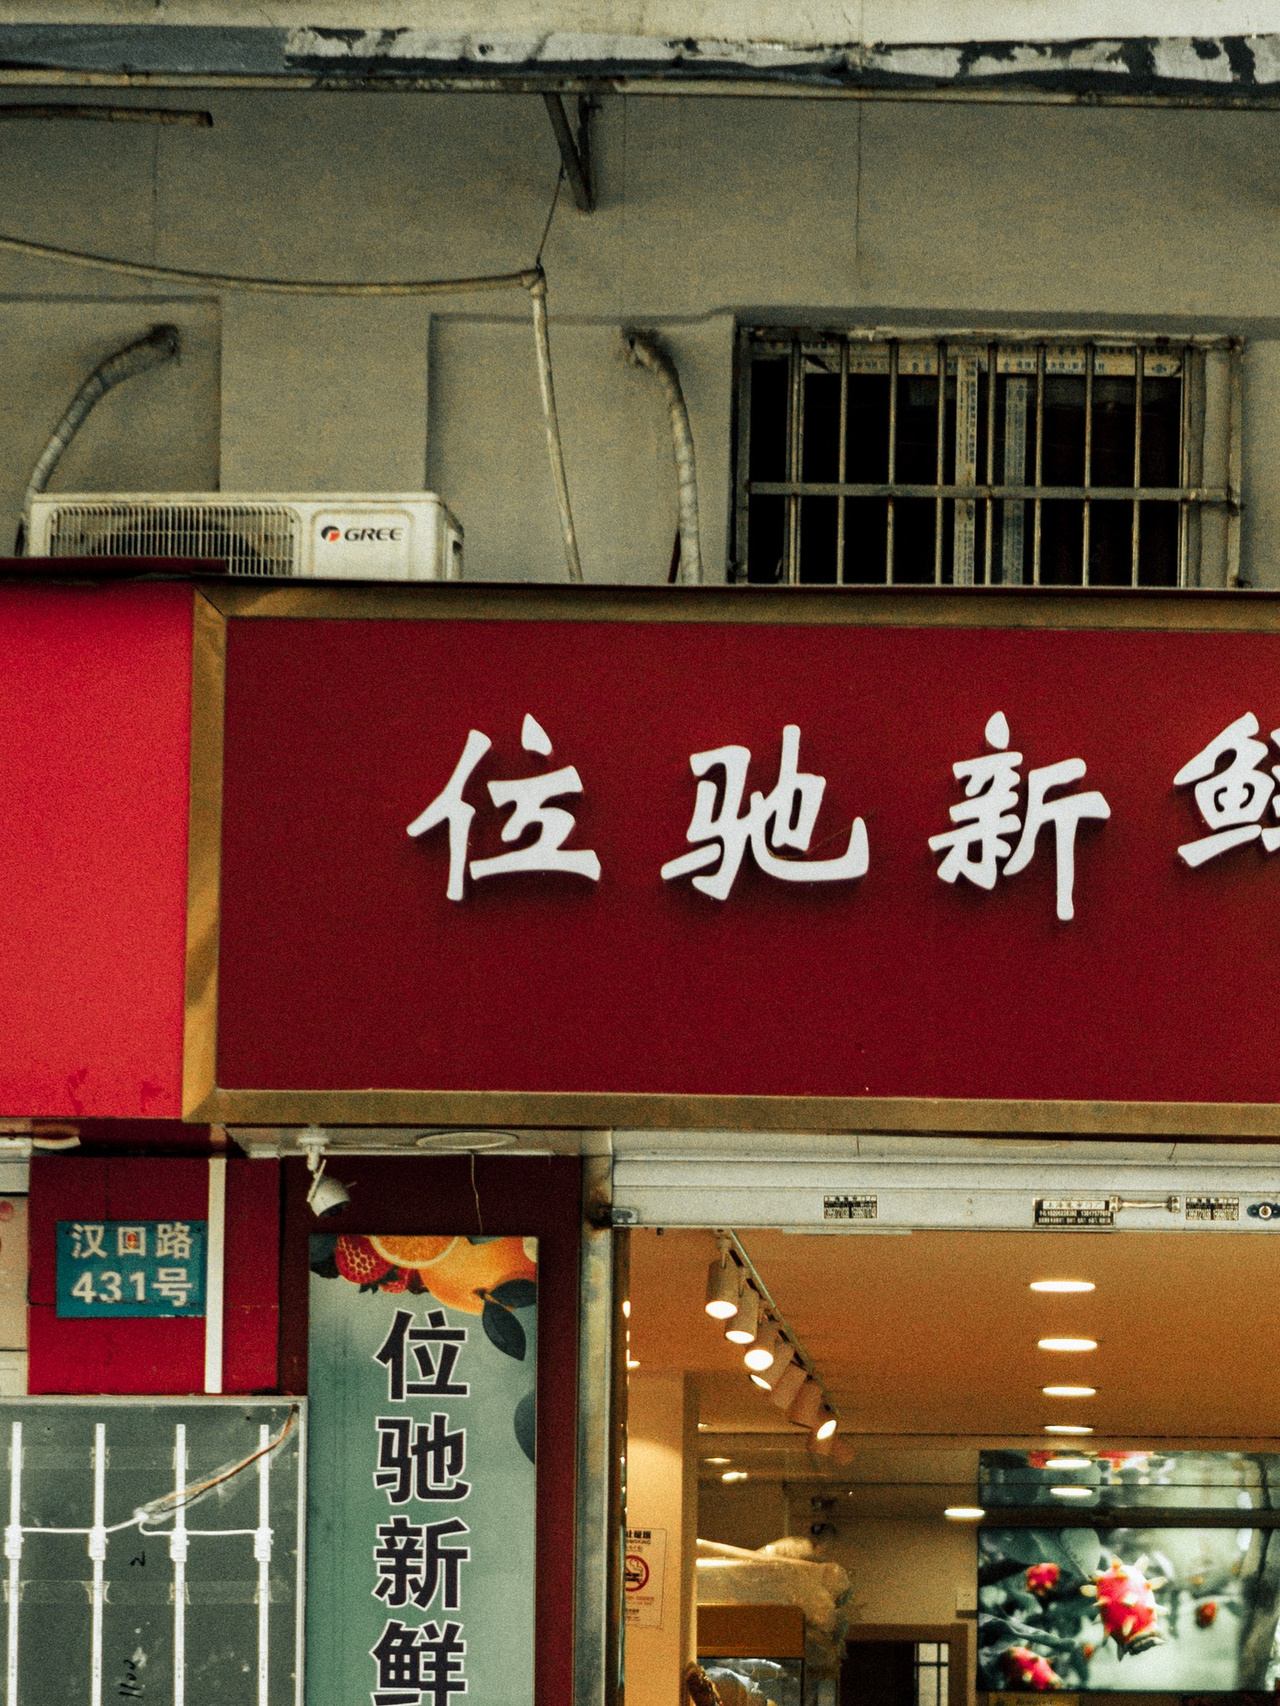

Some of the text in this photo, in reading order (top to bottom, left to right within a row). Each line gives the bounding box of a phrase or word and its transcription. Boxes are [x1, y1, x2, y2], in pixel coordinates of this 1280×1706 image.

[343, 525, 403, 543] GREE
[71, 1222, 194, 1259] 汉口路
[71, 1266, 194, 1307] 431号
